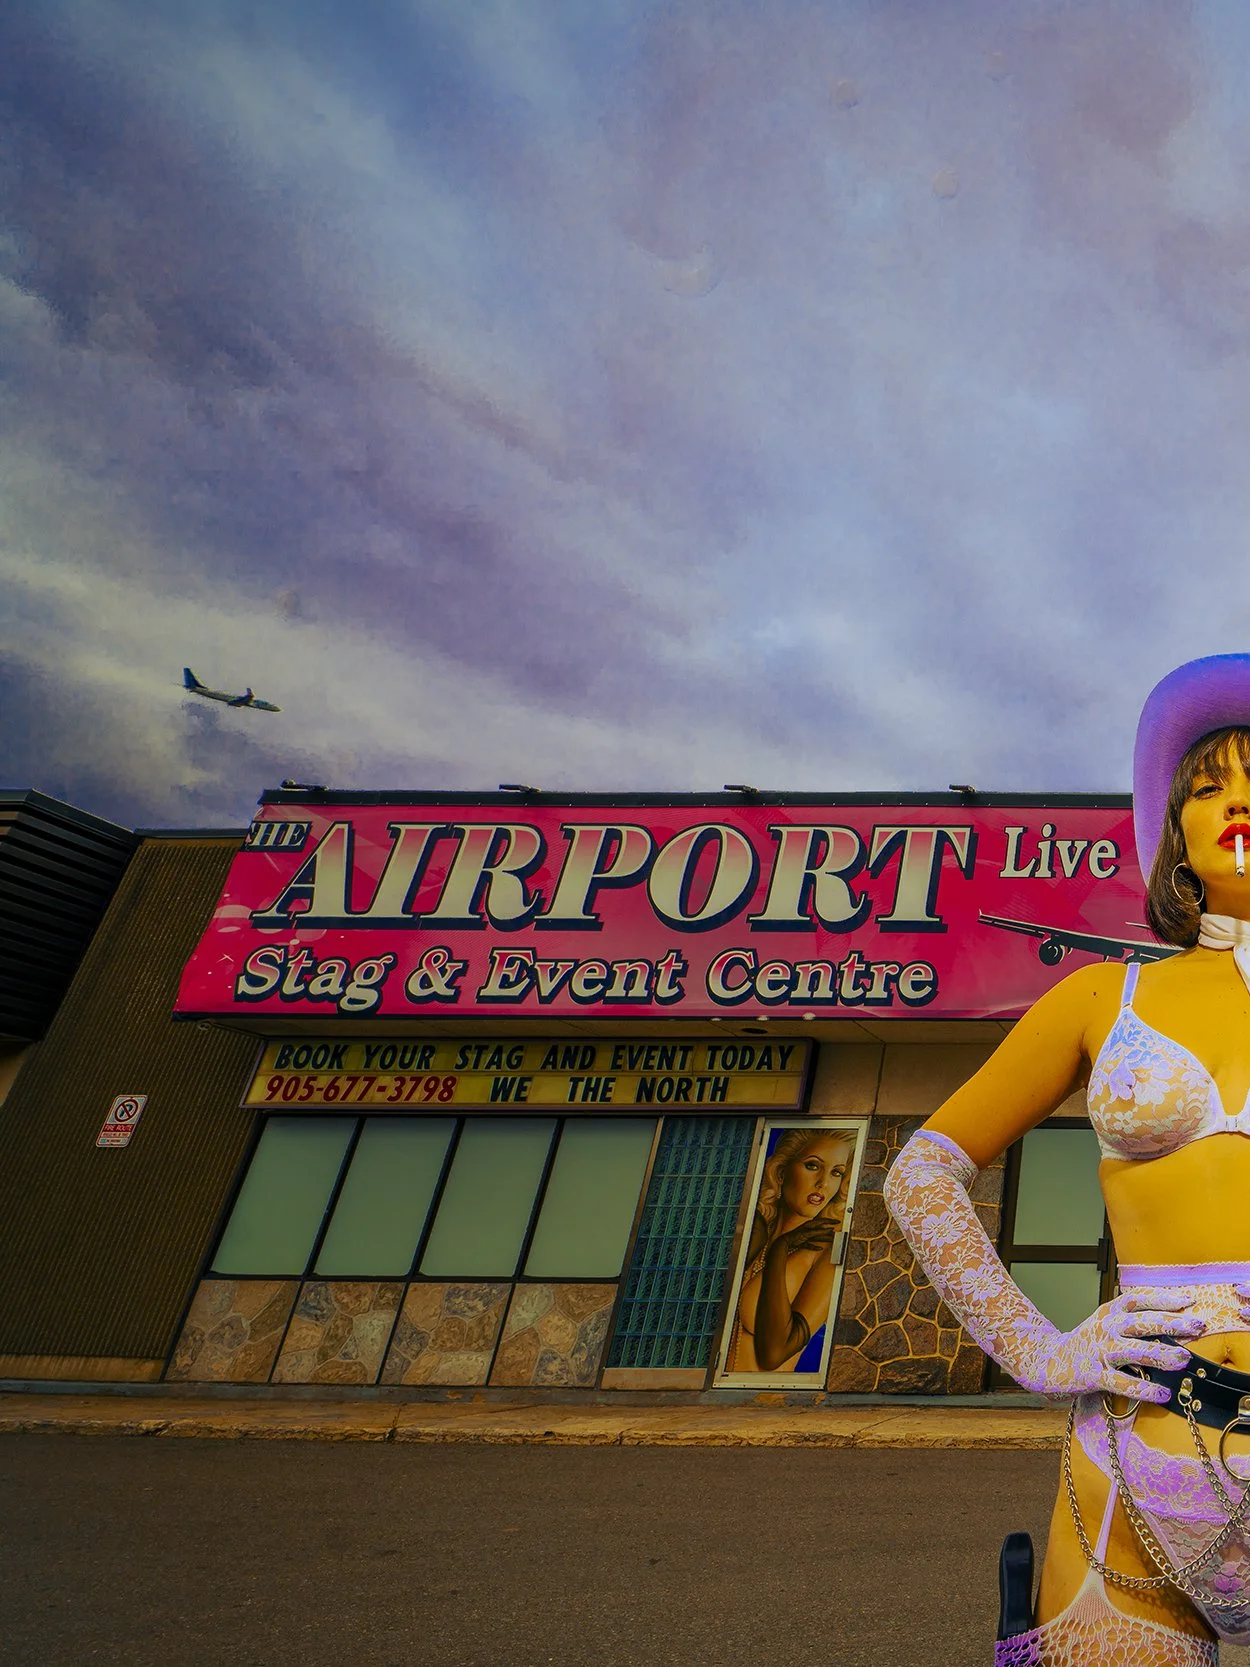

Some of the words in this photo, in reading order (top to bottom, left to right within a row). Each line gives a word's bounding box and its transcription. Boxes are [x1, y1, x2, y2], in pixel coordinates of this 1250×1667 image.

[251, 821, 977, 933] AIRPORT
[999, 823, 1120, 879] Live
[235, 943, 397, 1014] Stag
[406, 946, 469, 1003] &
[477, 947, 688, 1005] Event
[706, 947, 938, 1007] Centre
[274, 1044, 349, 1070] BOOK
[363, 1044, 437, 1070] YOUR
[454, 1045, 524, 1070] STAG
[540, 1045, 597, 1070] AND
[610, 1045, 694, 1071] EVENT
[707, 1045, 795, 1071] TODAY
[264, 1075, 458, 1103] 905-677-3798
[490, 1076, 532, 1103] WE
[567, 1076, 616, 1103] THE
[635, 1076, 729, 1103] NORTH
